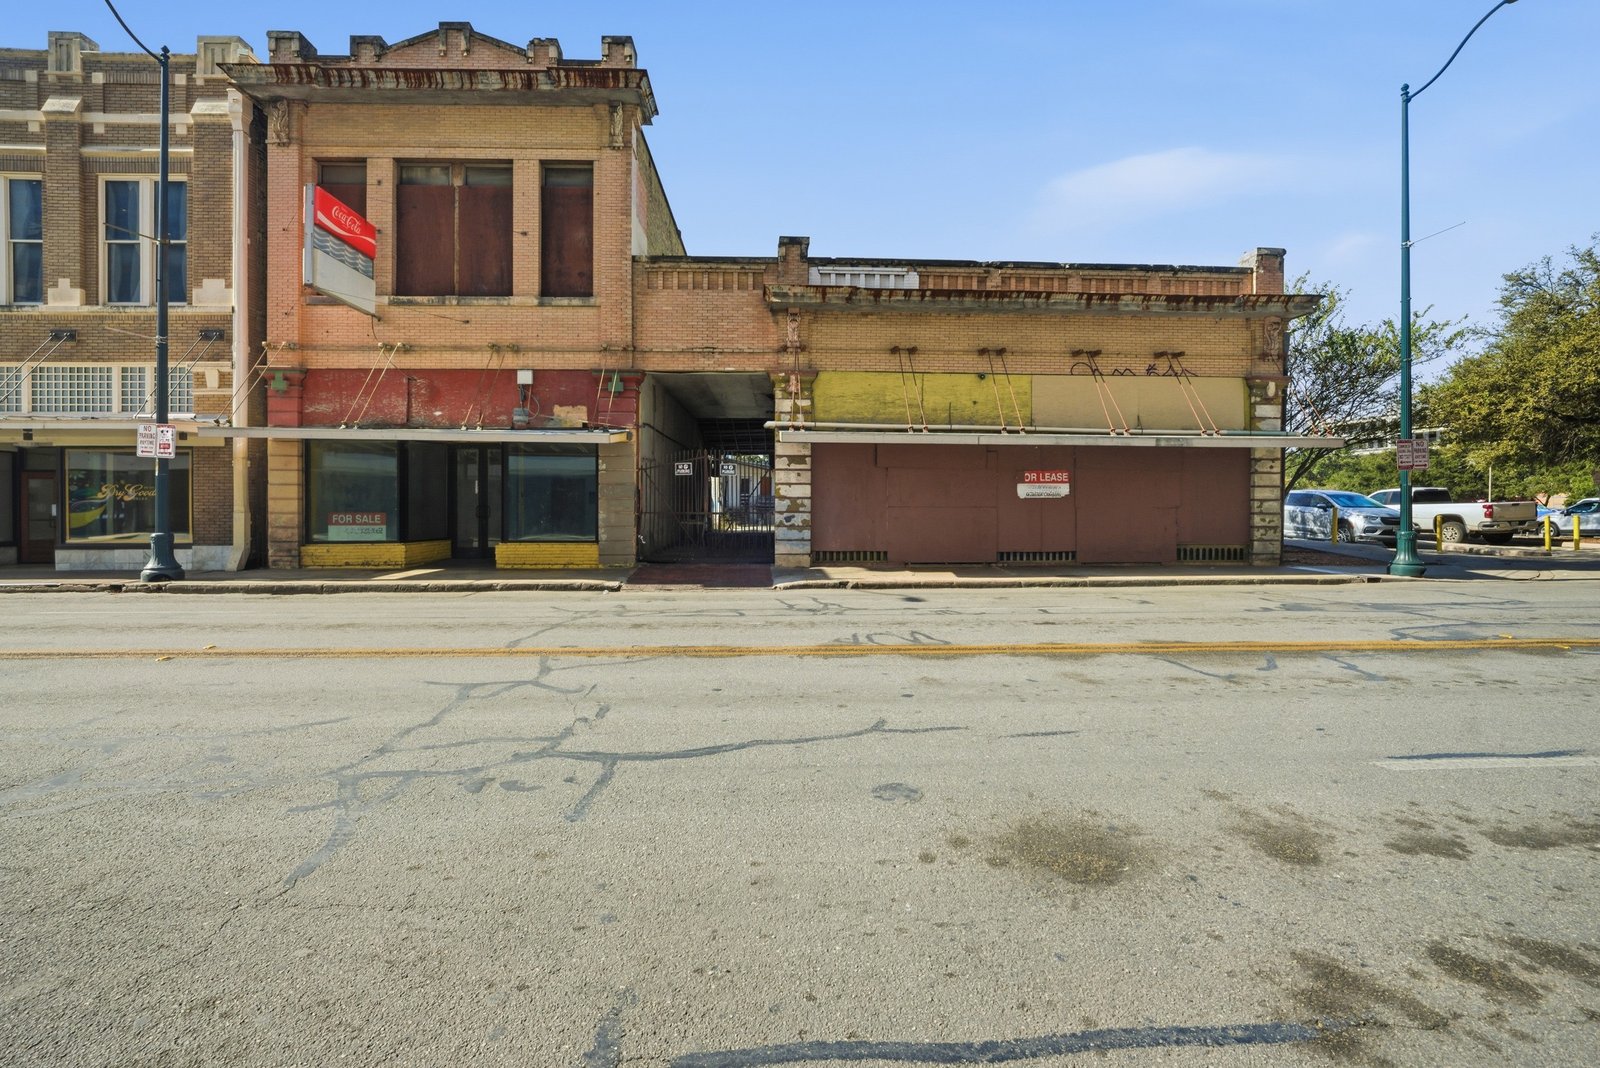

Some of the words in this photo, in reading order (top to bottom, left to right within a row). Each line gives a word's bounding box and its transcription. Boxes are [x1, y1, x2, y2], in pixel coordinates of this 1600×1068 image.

[1040, 473, 1069, 482] LEASE
[96, 483, 124, 500] Dry
[332, 514, 353, 523] FOR
[355, 514, 382, 523] SALE
